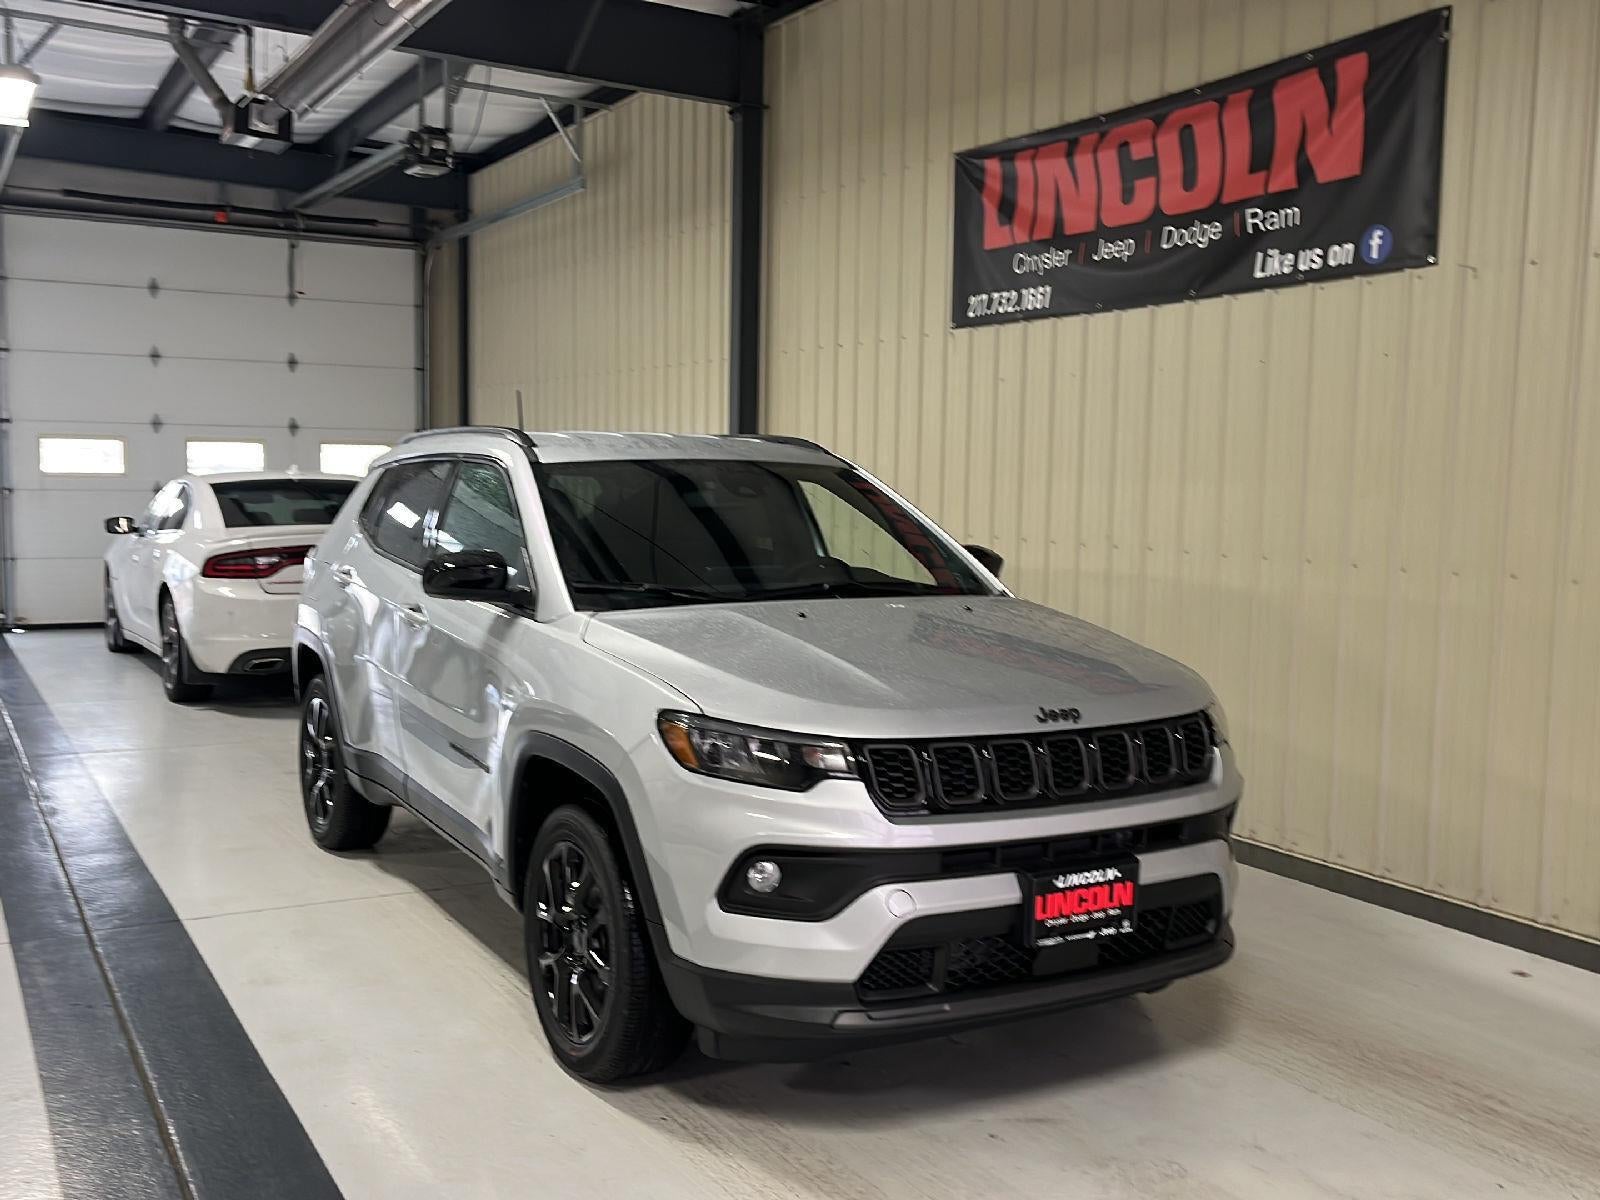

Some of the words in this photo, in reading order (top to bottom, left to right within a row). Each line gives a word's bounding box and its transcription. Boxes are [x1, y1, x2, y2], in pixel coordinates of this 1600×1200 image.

[982, 51, 1369, 250] LINCOLN
[1012, 247, 1072, 275] Chrysler
[1092, 238, 1136, 262] Jeep
[1160, 220, 1222, 249] Dodge
[1245, 206, 1300, 234] Ram
[1253, 248, 1295, 278] Like
[1297, 247, 1324, 271] us
[1327, 242, 1355, 267] on
[1034, 706, 1081, 724] Jeep
[1034, 880, 1134, 921] LINCOLN
